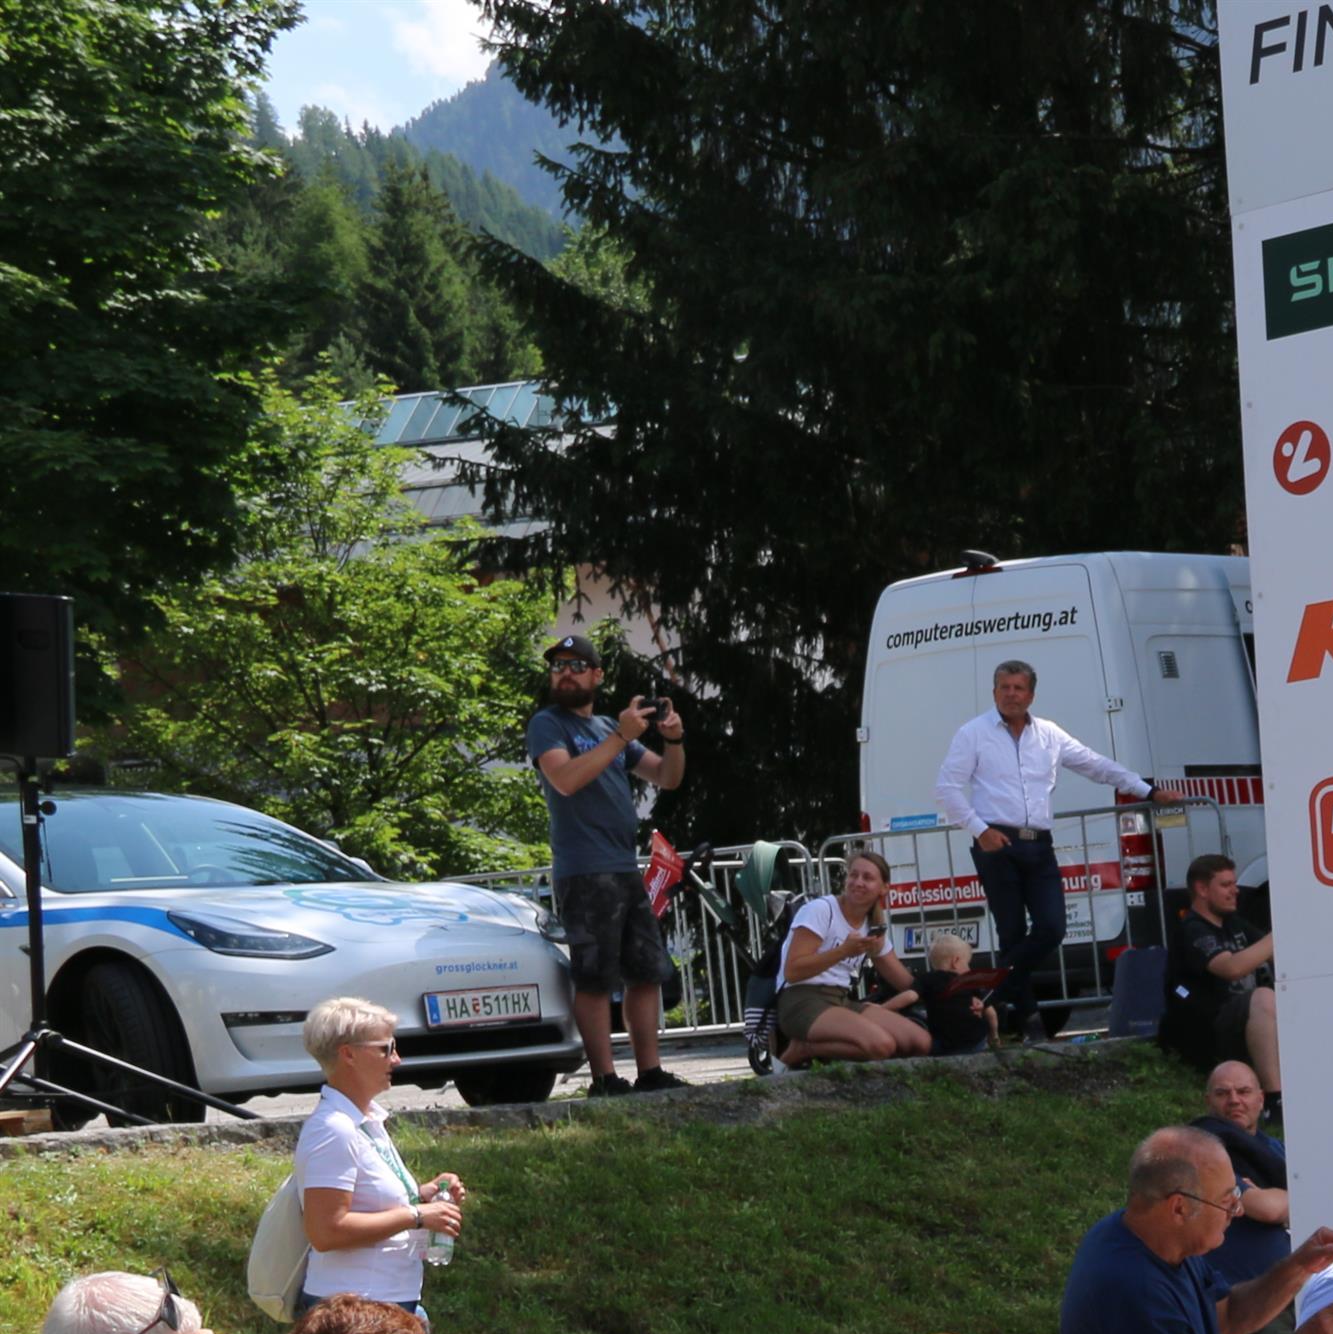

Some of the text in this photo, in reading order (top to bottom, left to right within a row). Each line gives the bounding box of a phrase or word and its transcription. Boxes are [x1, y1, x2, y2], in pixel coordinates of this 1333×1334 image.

[886, 606, 1078, 649] computerauswertung.at
[435, 960, 518, 975] grossglockner.at
[446, 992, 532, 1019] HA 511HX
